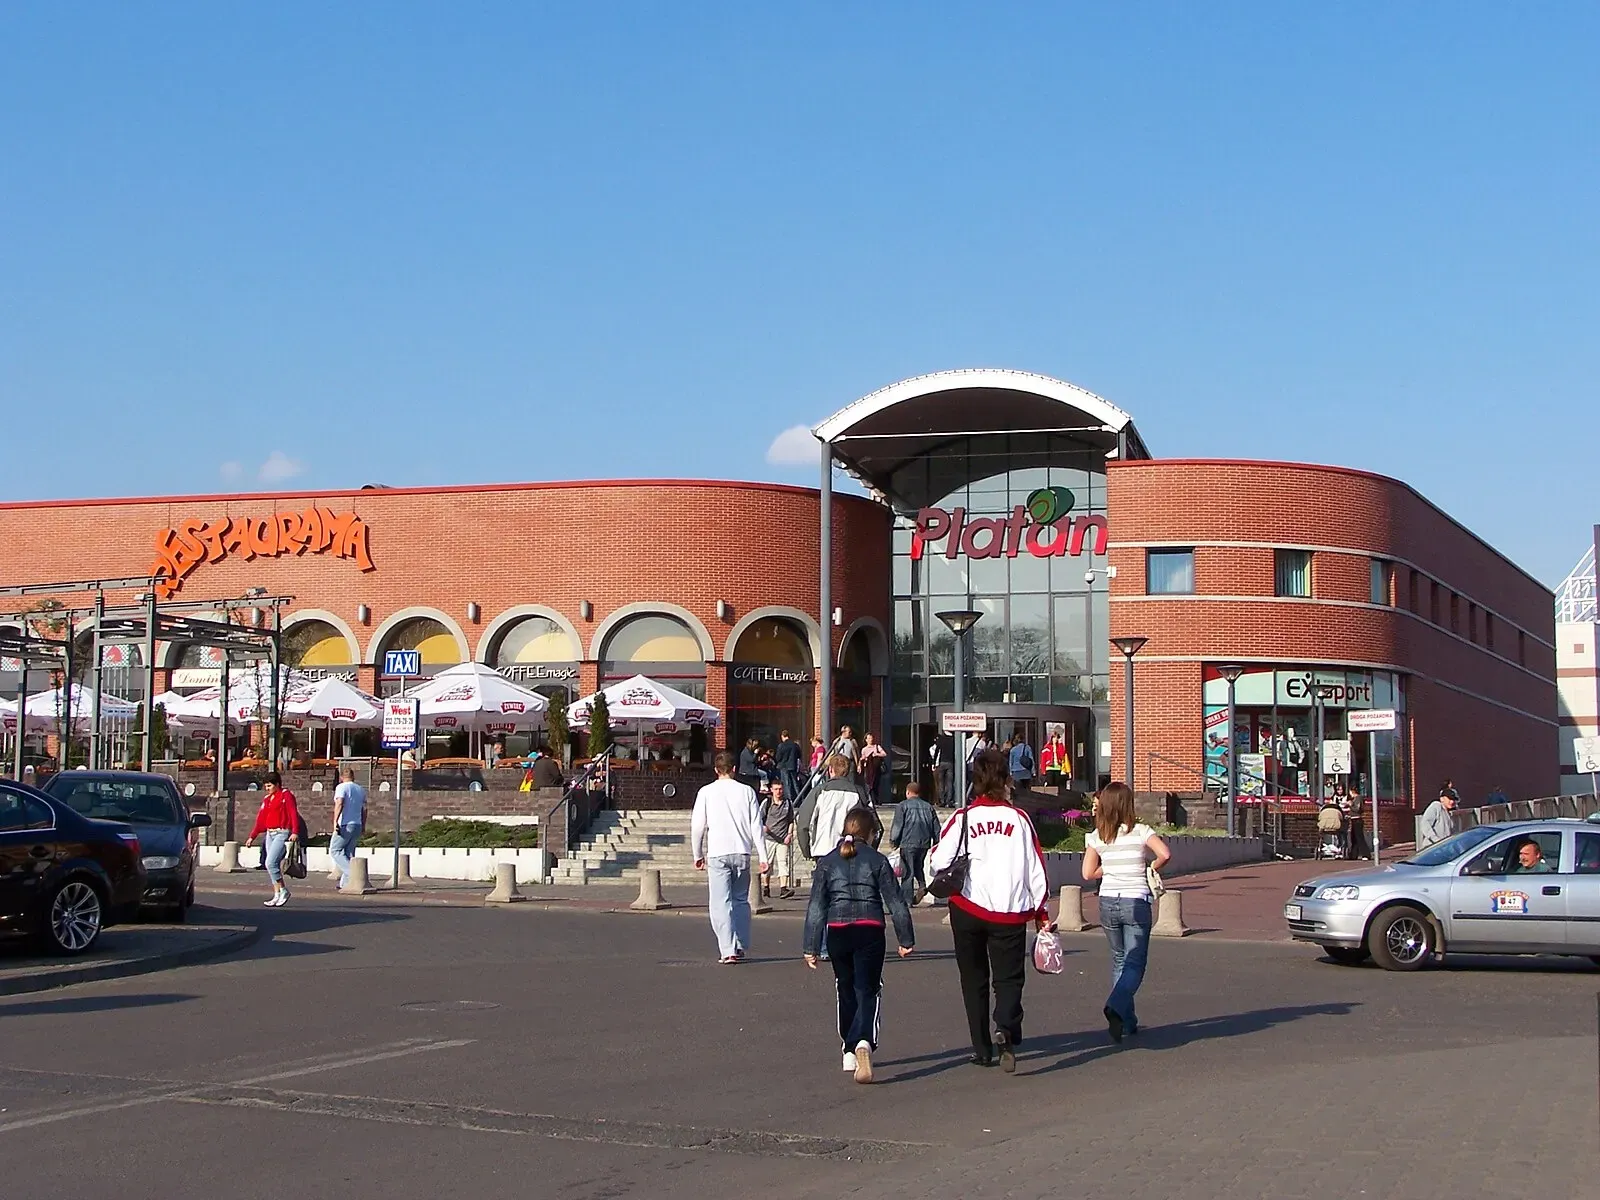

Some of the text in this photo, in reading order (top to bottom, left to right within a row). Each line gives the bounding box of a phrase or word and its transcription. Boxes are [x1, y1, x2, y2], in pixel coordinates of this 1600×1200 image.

[911, 505, 1108, 560] Platan
[148, 507, 374, 598] RESTAURAMA
[387, 653, 416, 673] TAXI
[390, 704, 412, 716] West
[970, 821, 1014, 838] JAPAN
